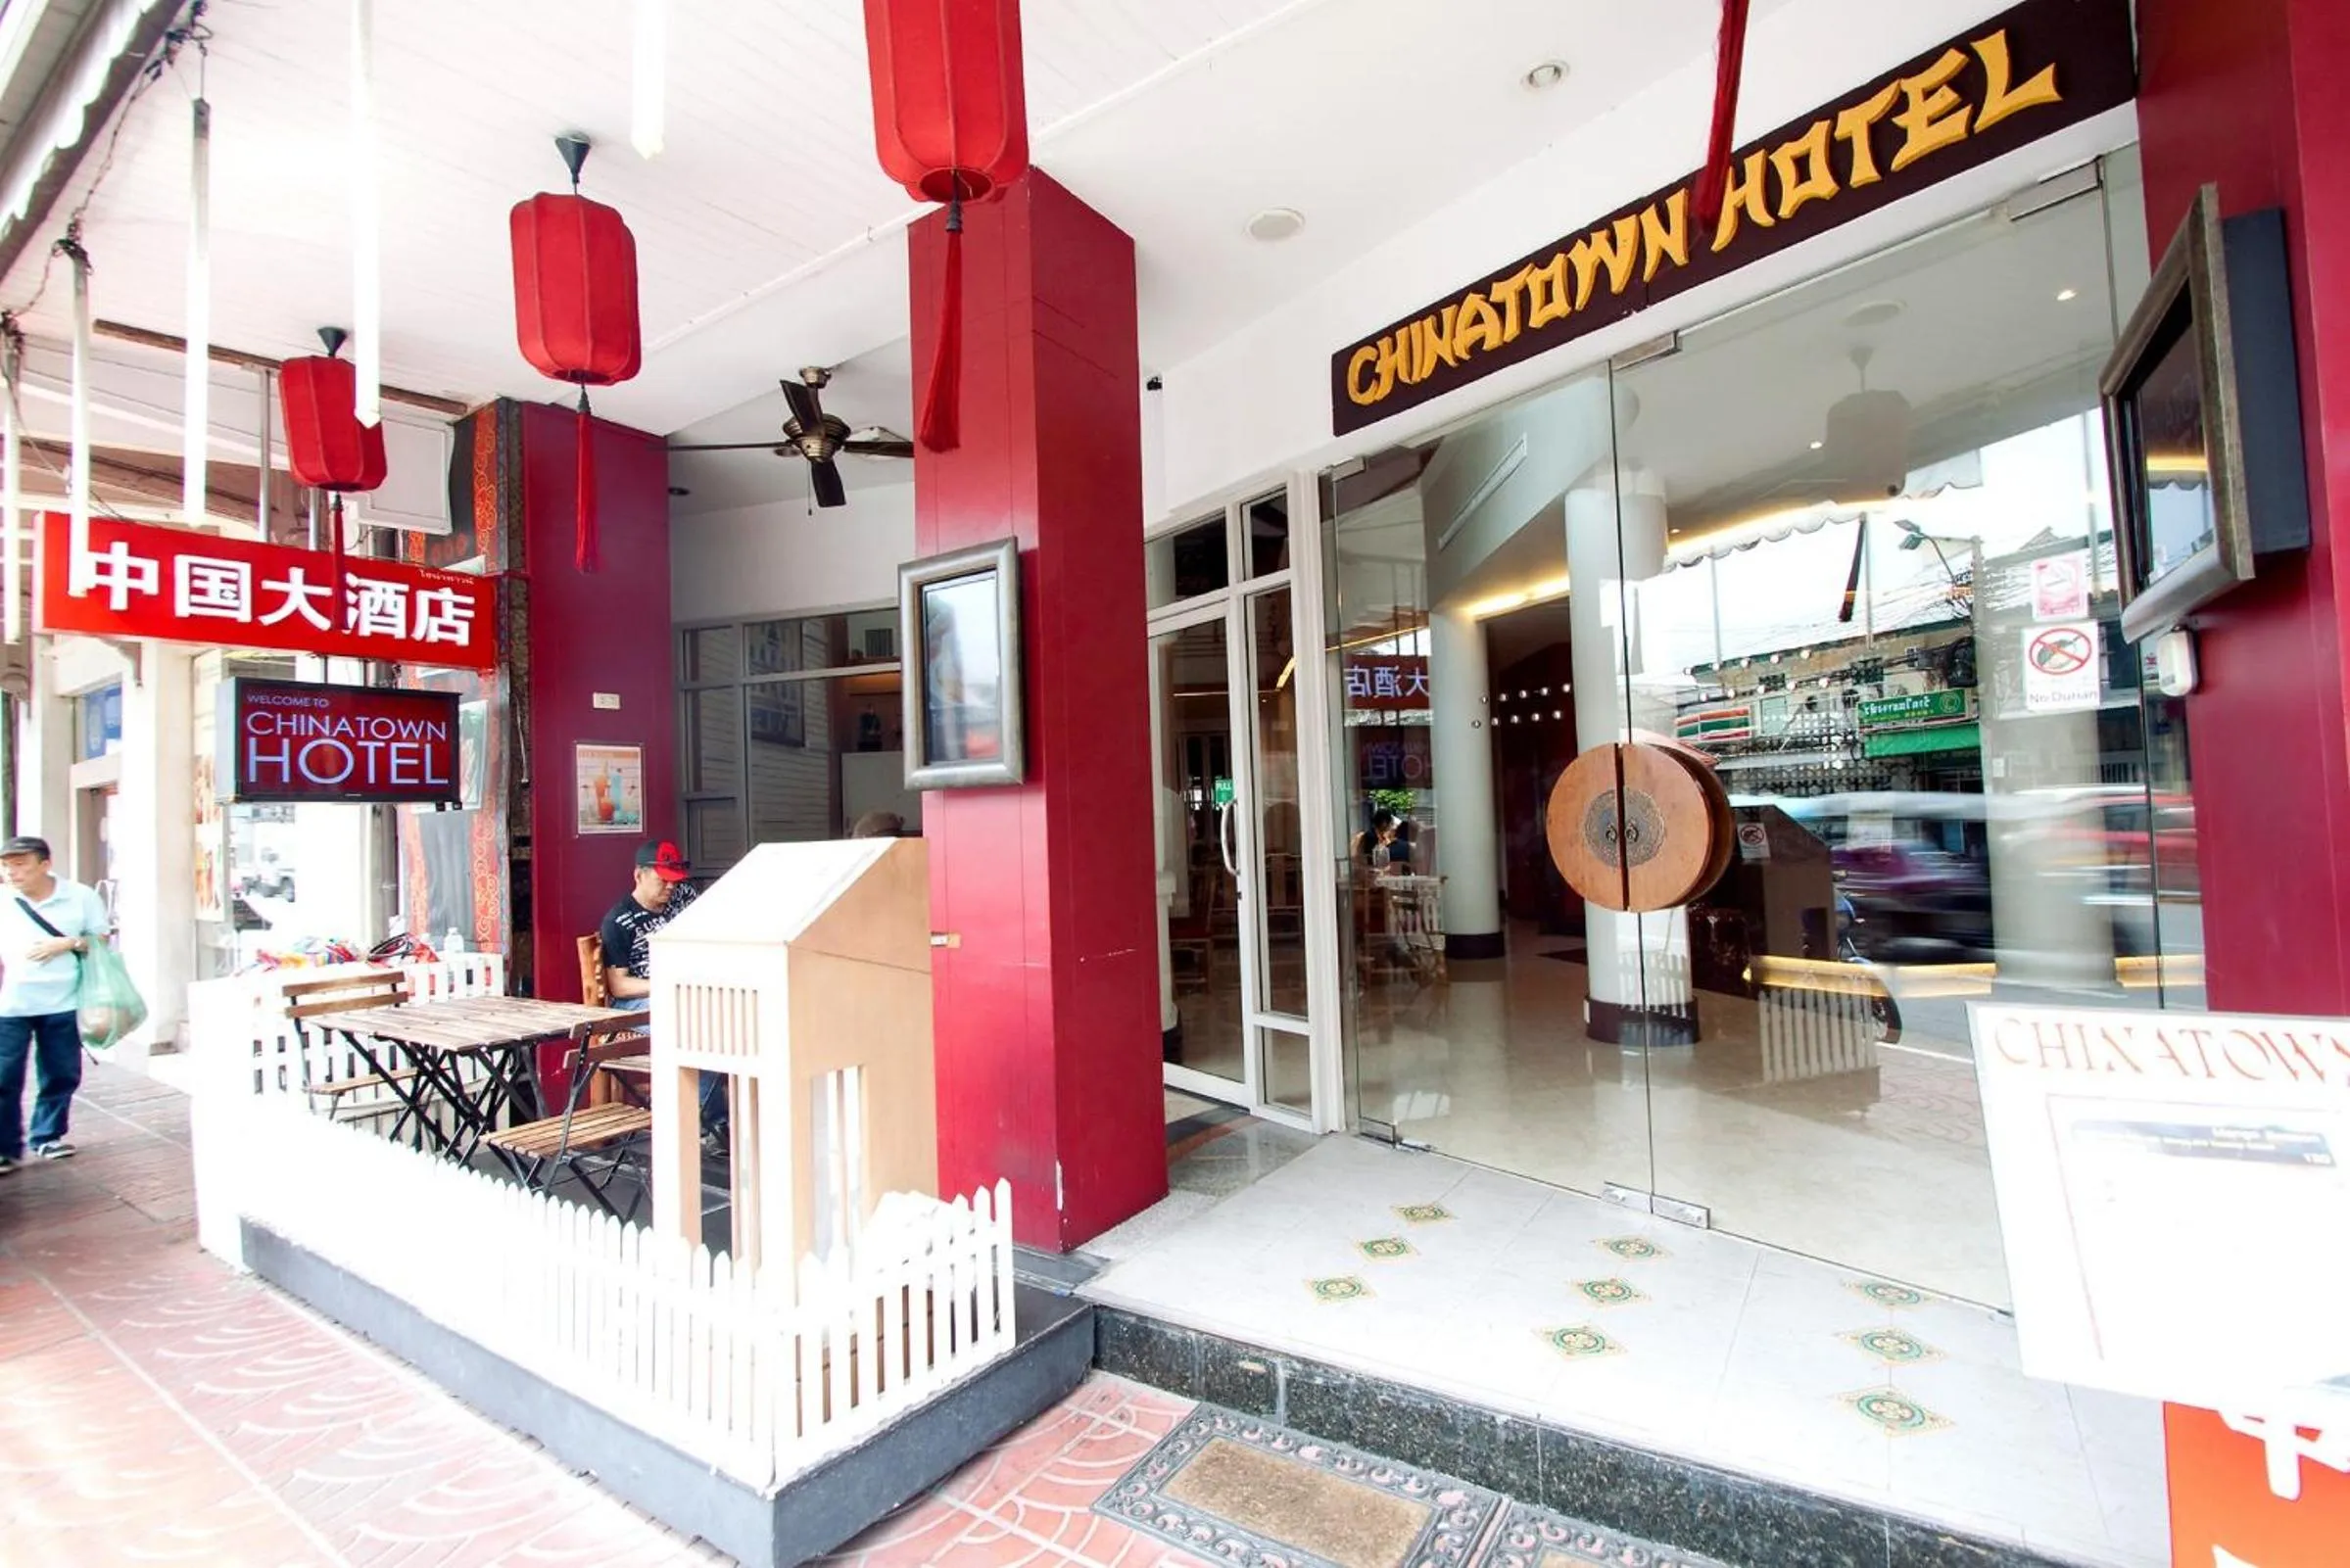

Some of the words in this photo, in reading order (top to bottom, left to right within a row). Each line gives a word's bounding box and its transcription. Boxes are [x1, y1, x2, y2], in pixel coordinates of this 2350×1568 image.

[1347, 188, 1689, 405] CHINATOWN
[1710, 28, 2062, 252] HOTEL
[84, 541, 476, 646] 中国大酒店
[247, 694, 311, 707] WELCOME
[313, 697, 329, 707] TO
[247, 711, 446, 741] CHINATOWN
[249, 736, 449, 784] HOTEL
